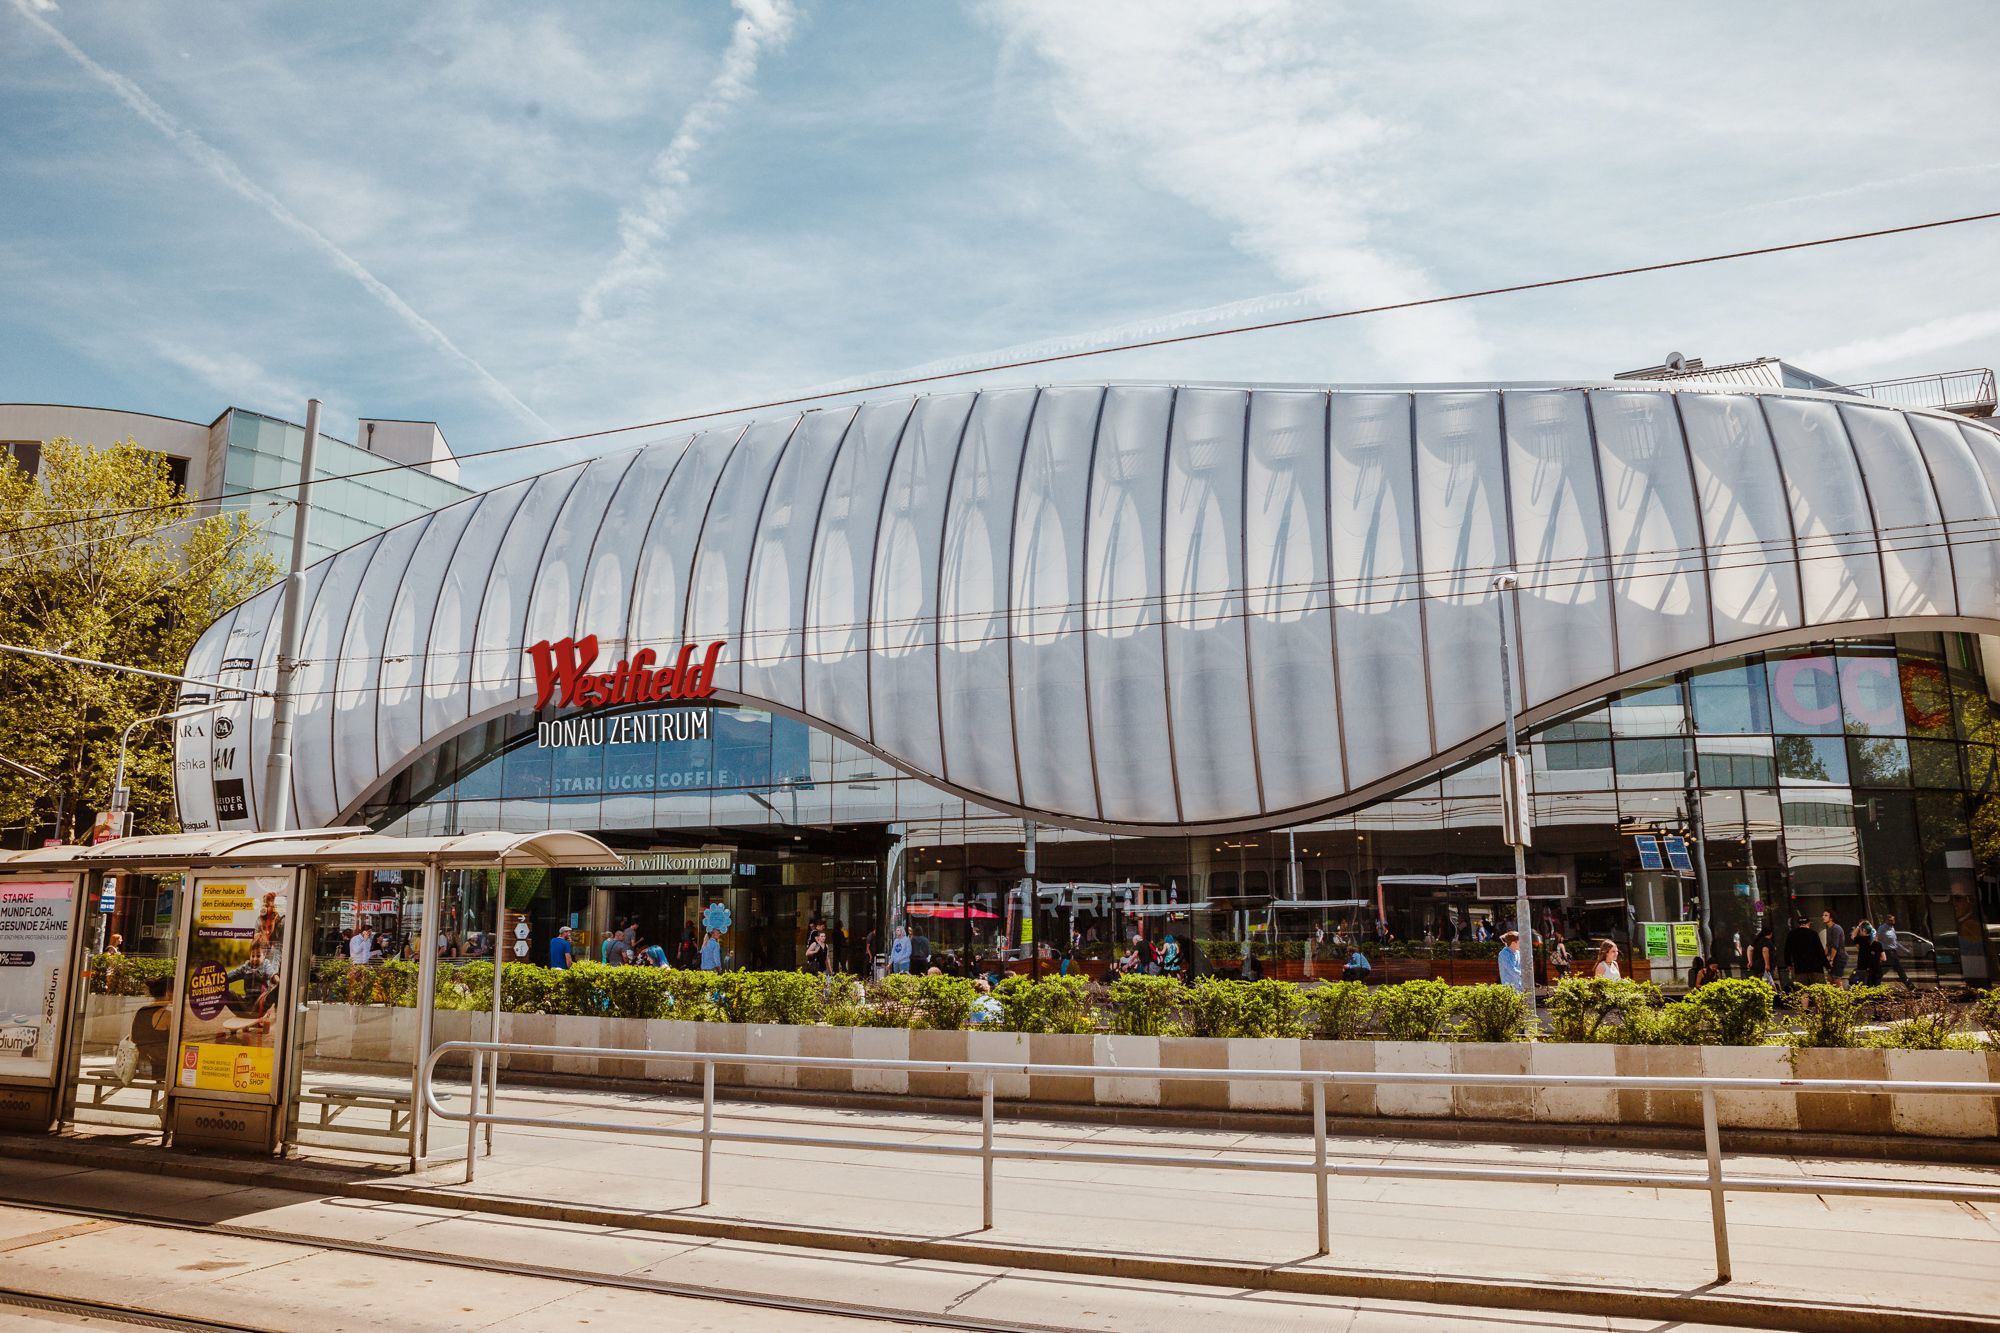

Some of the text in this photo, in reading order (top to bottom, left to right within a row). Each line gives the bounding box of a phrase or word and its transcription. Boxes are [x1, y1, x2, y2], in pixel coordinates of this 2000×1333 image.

[525, 634, 727, 710] Westfield
[180, 725, 204, 738] ARA
[538, 711, 708, 749] DONAU ZENTRUM
[640, 854, 727, 870] willkommen
[203, 887, 221, 895] Früher
[222, 887, 235, 895] habe
[2, 893, 34, 903] STARKE
[213, 900, 253, 909] Einkaufswagen
[0, 906, 54, 917] MUNDFLORA.
[200, 914, 232, 922] geschoben.
[0, 918, 69, 931] GESUNDE ZÄHNE
[199, 929, 210, 937] Dann
[191, 972, 226, 988] GRATIS
[46, 968, 59, 1024] zendium
[191, 985, 226, 996] ZUSTELLUNG
